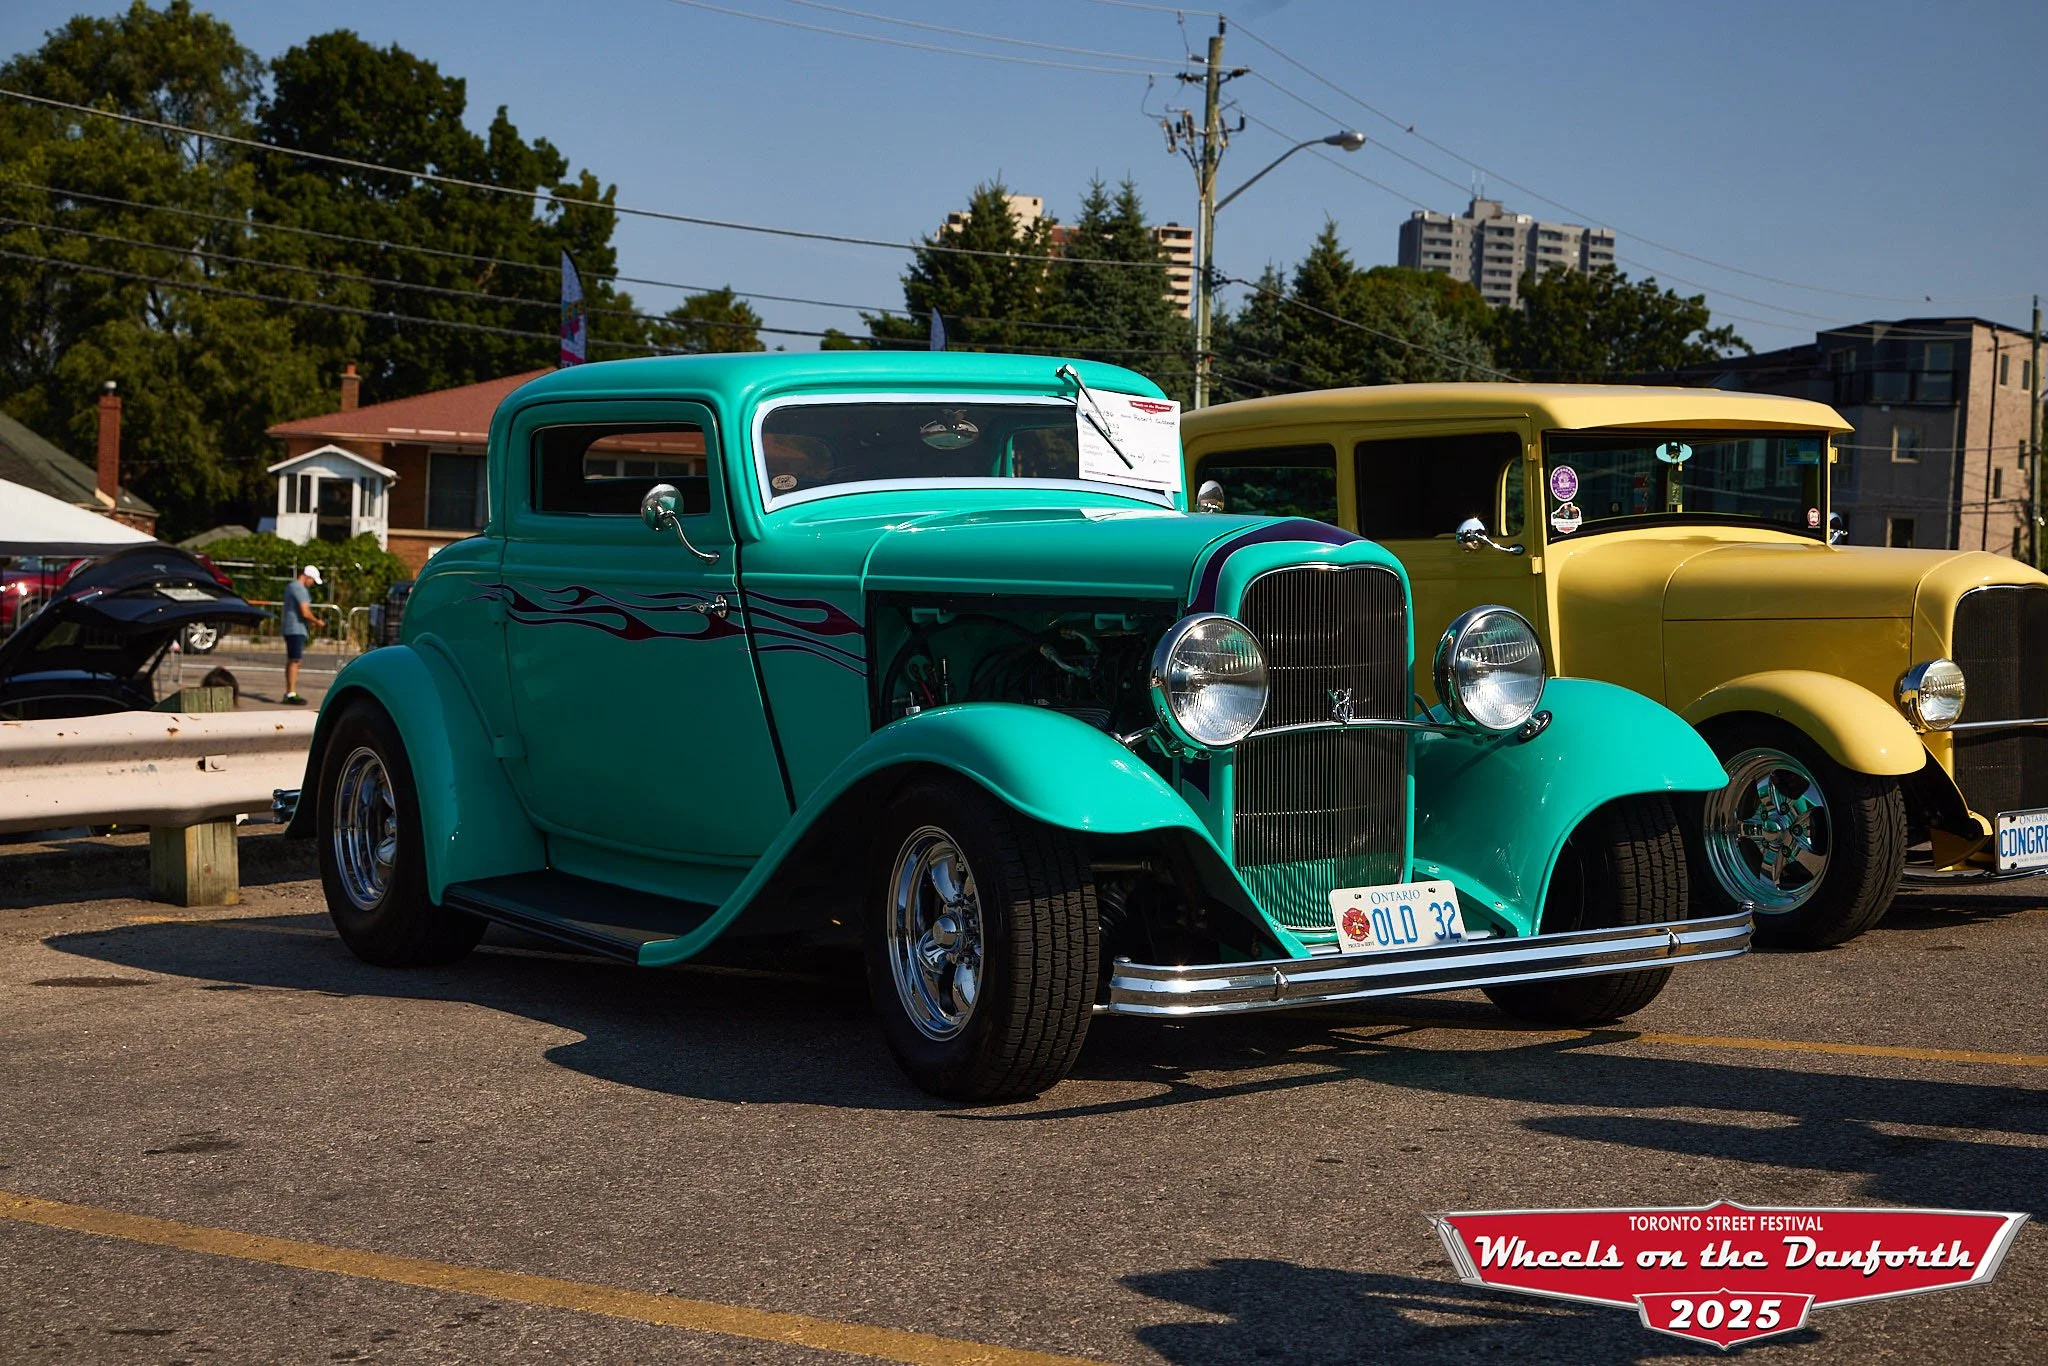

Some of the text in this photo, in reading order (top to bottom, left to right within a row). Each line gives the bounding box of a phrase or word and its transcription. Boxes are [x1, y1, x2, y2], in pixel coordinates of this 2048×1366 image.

[1370, 888, 1421, 905] ONTARIO
[1371, 900, 1462, 946] OLD 32
